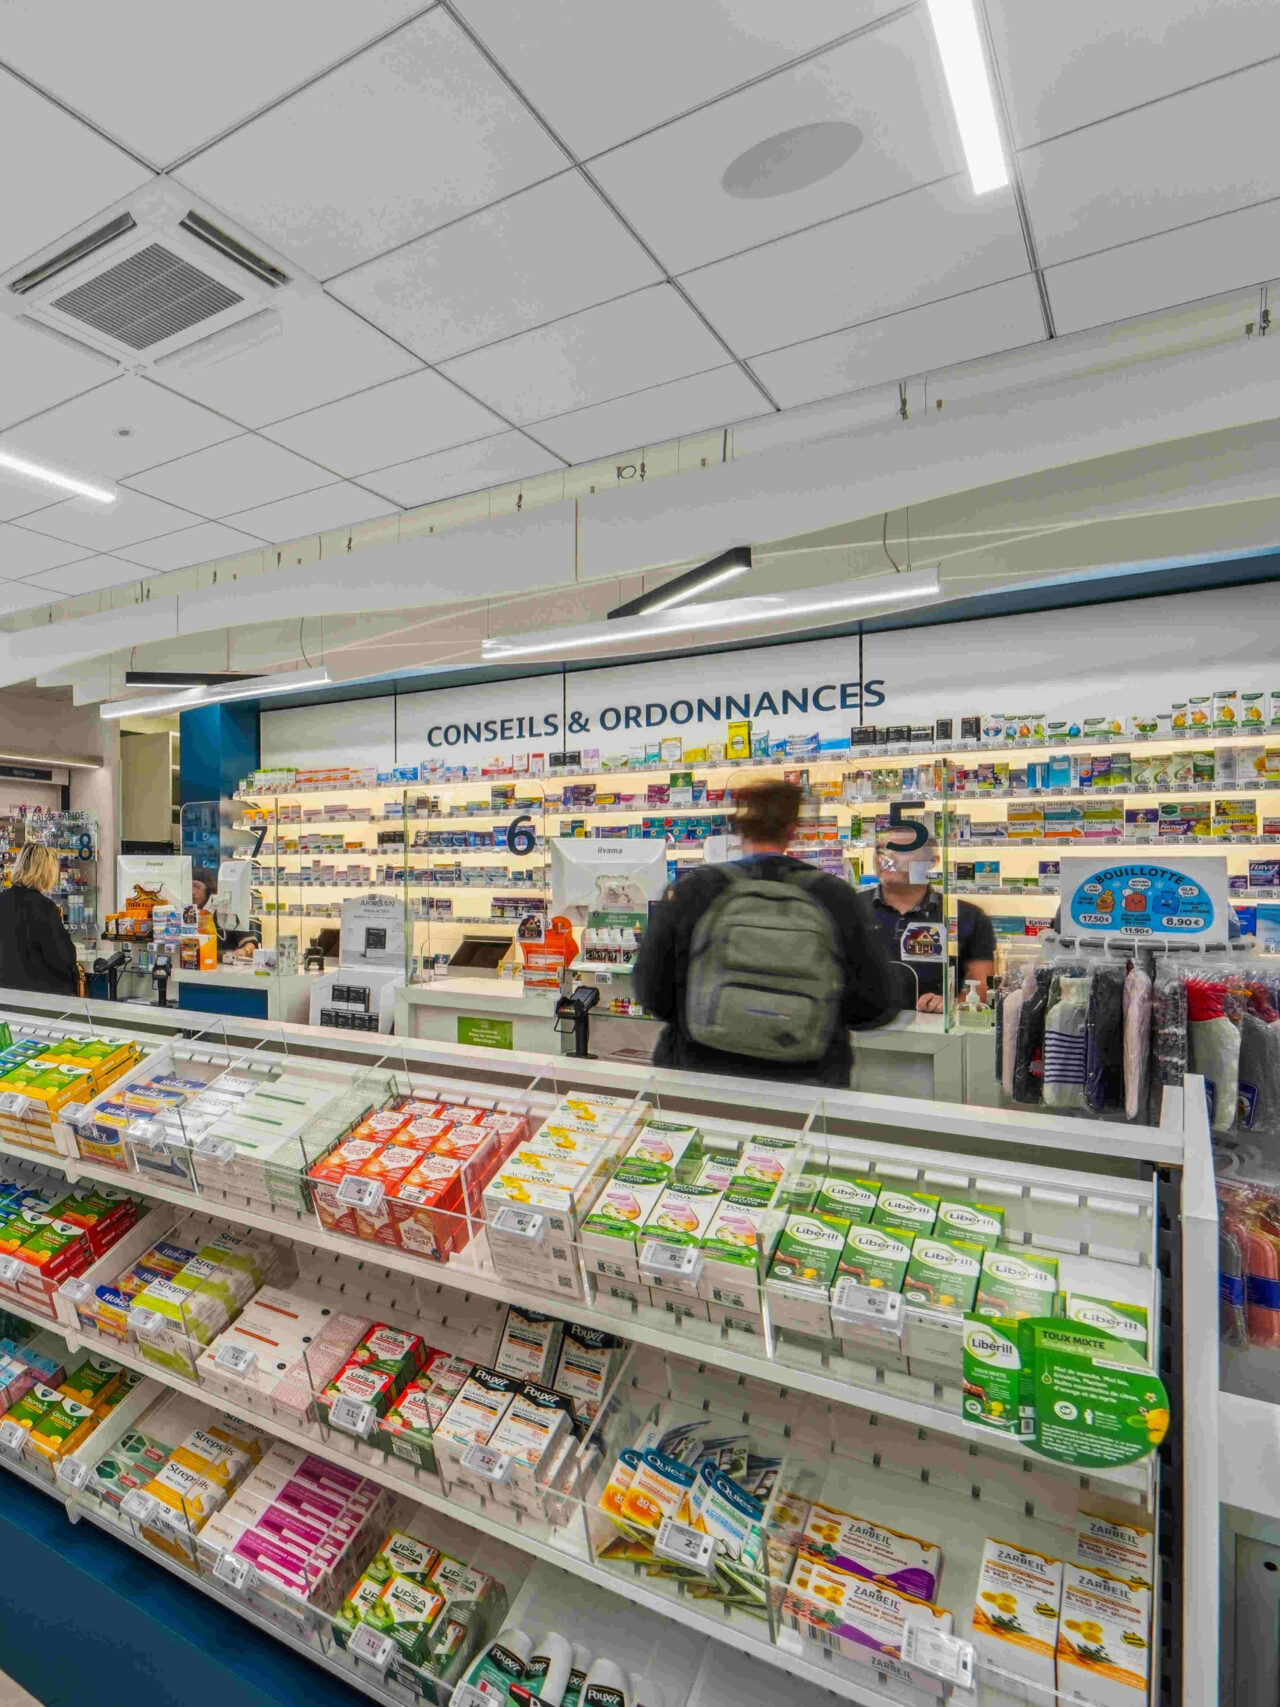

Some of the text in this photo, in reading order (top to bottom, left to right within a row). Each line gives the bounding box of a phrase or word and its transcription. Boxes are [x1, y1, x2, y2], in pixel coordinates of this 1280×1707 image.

[427, 679, 885, 747] CONSEILS & ORDONNANCES
[507, 815, 536, 857] 6
[885, 800, 929, 851] 5
[79, 832, 93, 861] 8
[249, 826, 268, 859] 7
[1095, 866, 1186, 885] BOUILLOTTE
[831, 1187, 871, 1201] Liberill
[888, 1200, 930, 1215] Liberill
[949, 1212, 995, 1227] Liberill
[796, 1225, 839, 1242] Liberill
[858, 1237, 904, 1253] Liberill
[923, 1250, 973, 1267] Liberill
[995, 1264, 1048, 1282] Liberill
[1083, 1312, 1138, 1330] Liberill
[380, 1333, 405, 1346] UPSA
[972, 1337, 1013, 1355] Liberill
[1042, 1330, 1072, 1344] TOUX
[1072, 1336, 1106, 1350] MIXTE
[350, 1371, 376, 1385] UPSA
[194, 1430, 236, 1457] Strepsils
[167, 1463, 210, 1492] Strepsils
[848, 1523, 892, 1546] ZARBEIL
[1090, 1522, 1139, 1546] ZARBEIL
[393, 1541, 423, 1561] UPSA
[998, 1549, 1047, 1573] ZARBEIL
[395, 1586, 426, 1609] UPSA
[1079, 1575, 1132, 1600] ZARBEIL
[854, 1585, 901, 1612] ZARBEIL
[871, 1656, 913, 1681] ZARBEIL
